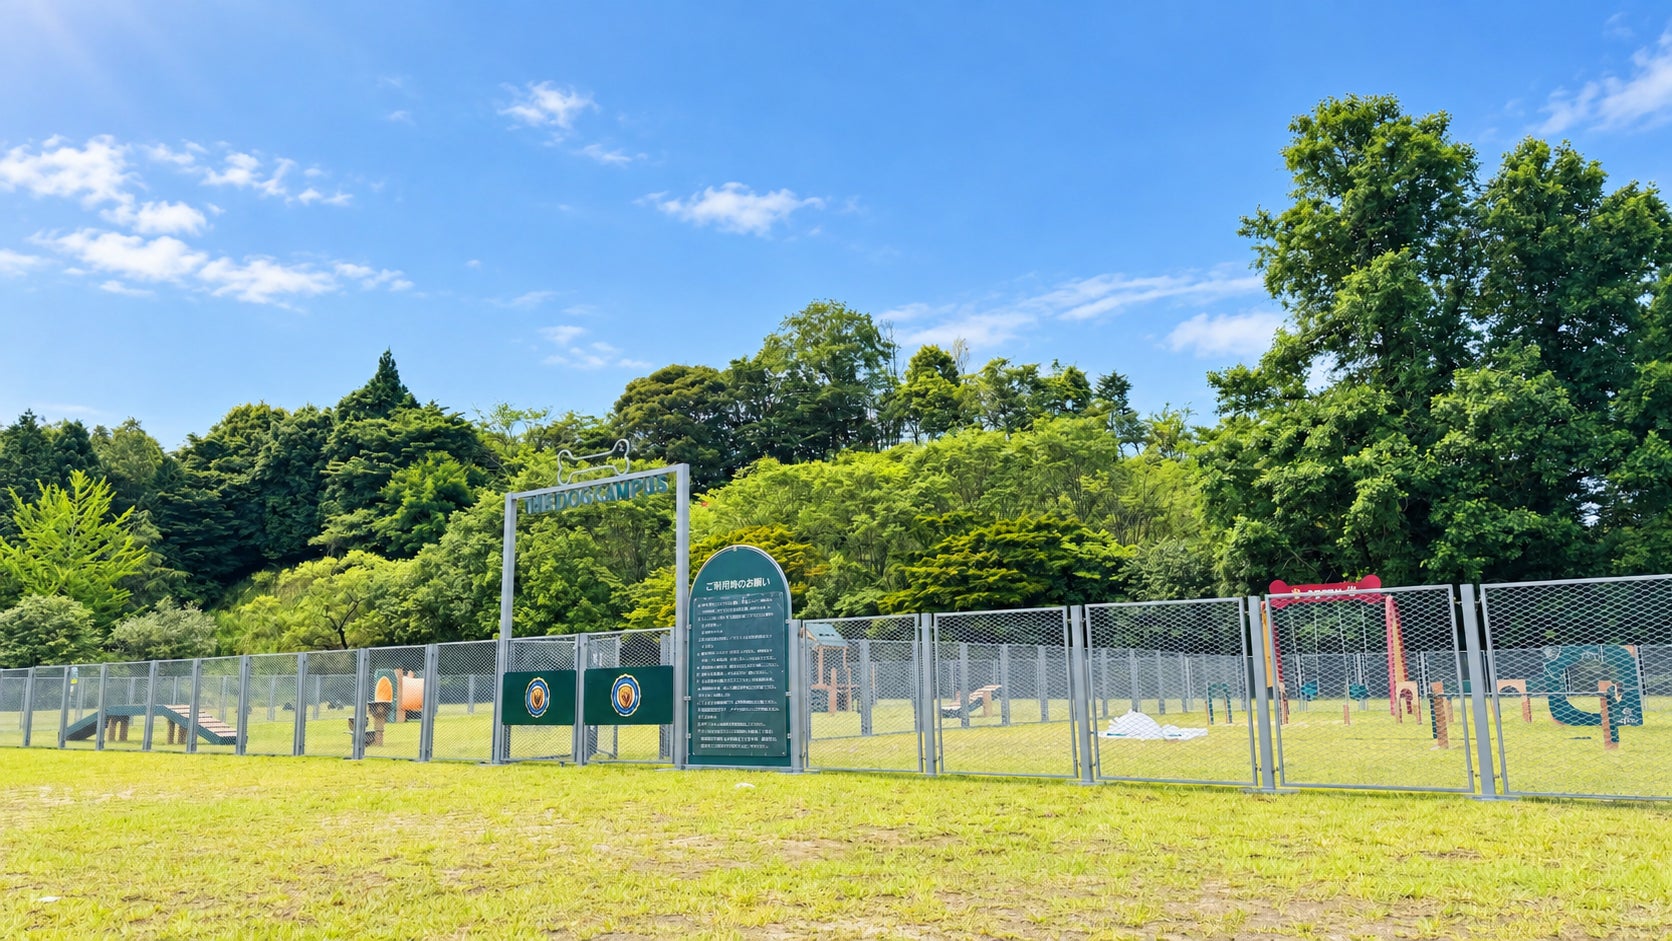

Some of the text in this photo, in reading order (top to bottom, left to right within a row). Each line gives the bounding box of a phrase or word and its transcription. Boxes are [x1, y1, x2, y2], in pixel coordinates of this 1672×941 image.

[525, 475, 669, 514] THE DOG CAMPUS
[706, 578, 770, 591] ご利用時のお願い
